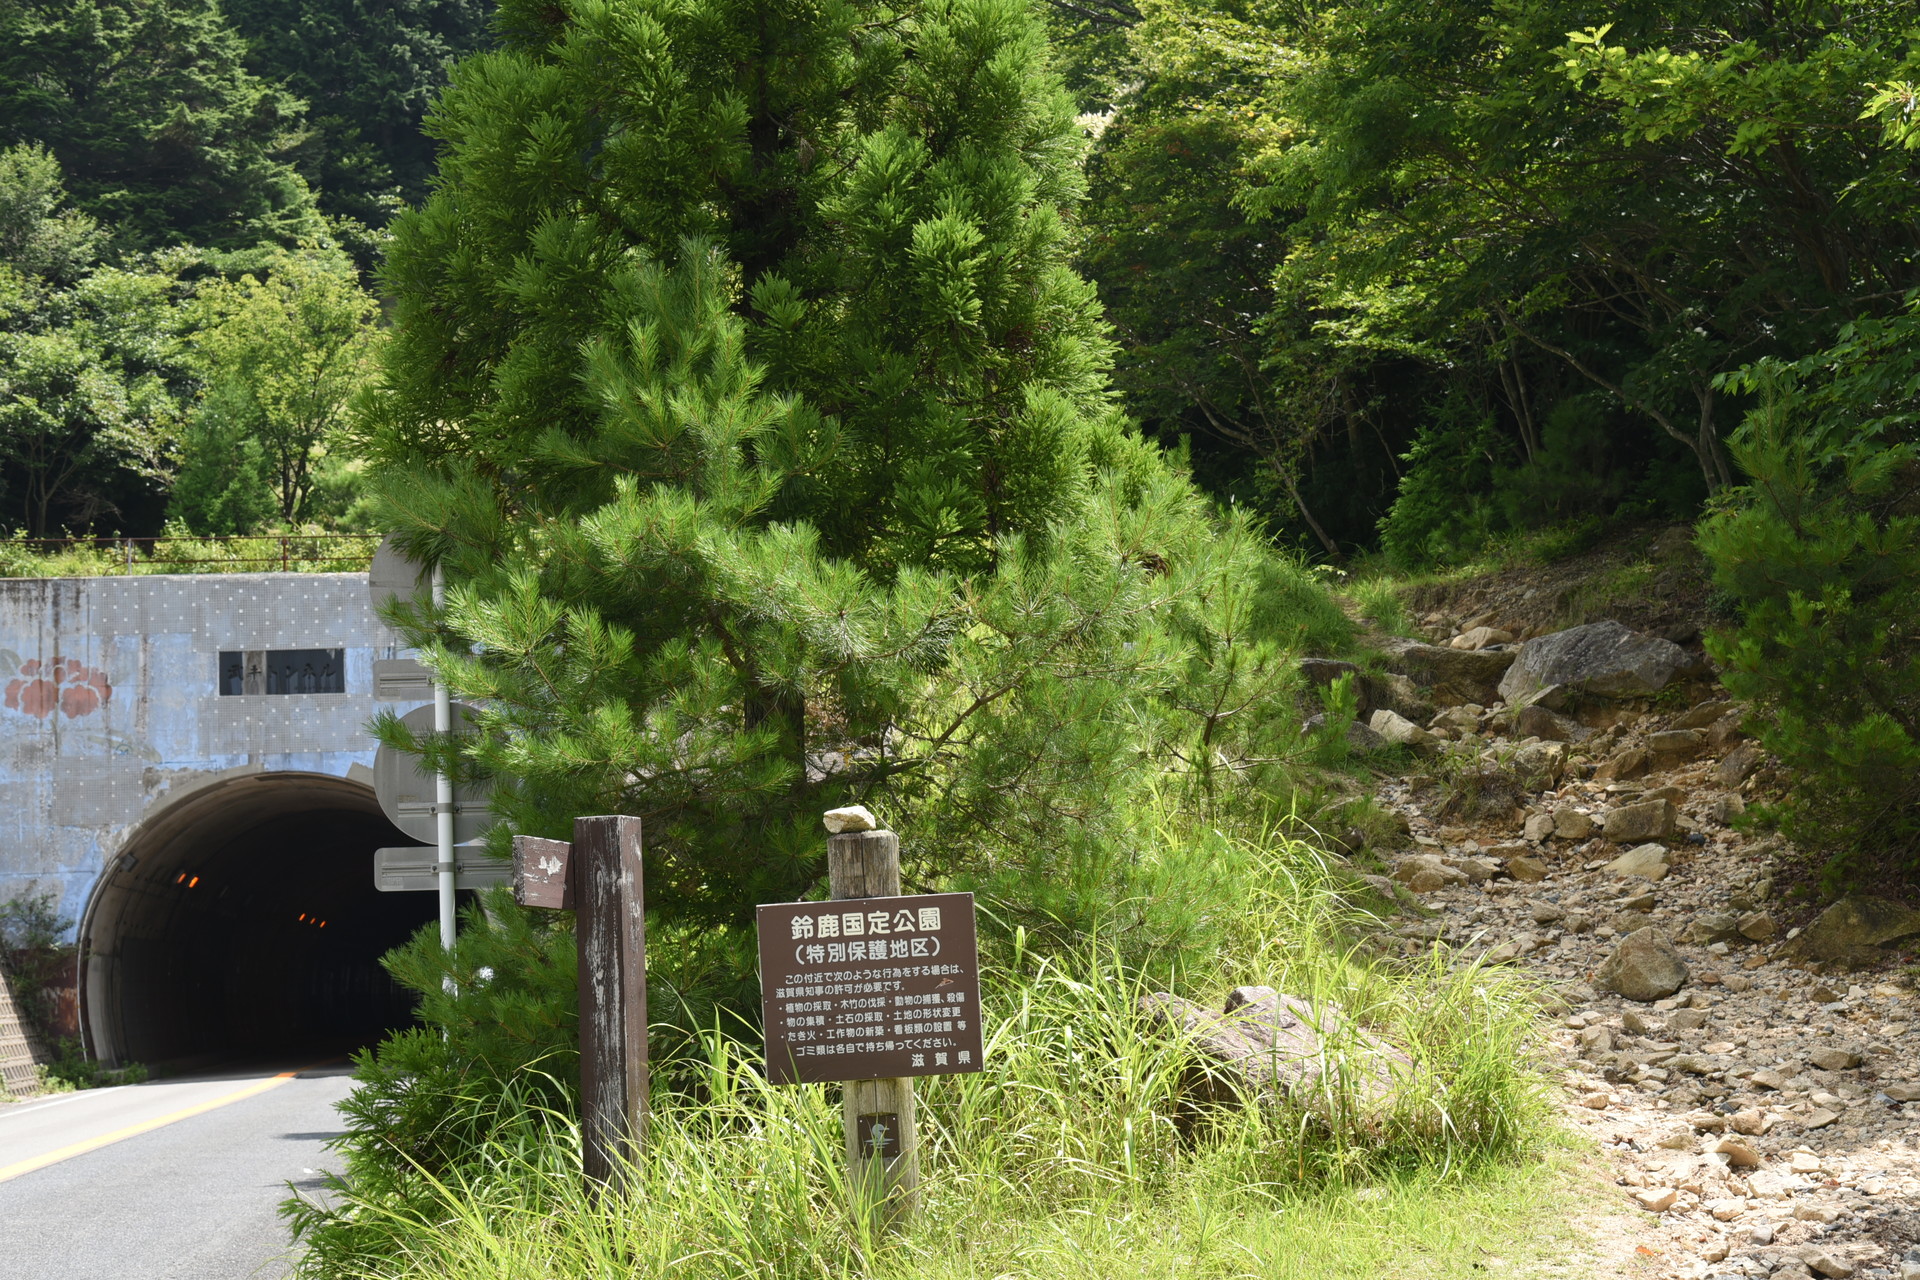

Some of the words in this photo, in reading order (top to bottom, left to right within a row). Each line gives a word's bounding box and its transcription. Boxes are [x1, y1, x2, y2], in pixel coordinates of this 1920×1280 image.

[791, 907, 941, 940] 鈴鹿国定公園
[795, 936, 941, 965] （特別保護地区）
[785, 964, 964, 985] この付近で次のような行為をする場合は、
[775, 981, 905, 998] 滋賀県知事の許可が必要です。
[796, 1037, 957, 1057] ゴミ類は各自で持ち帰ってください。
